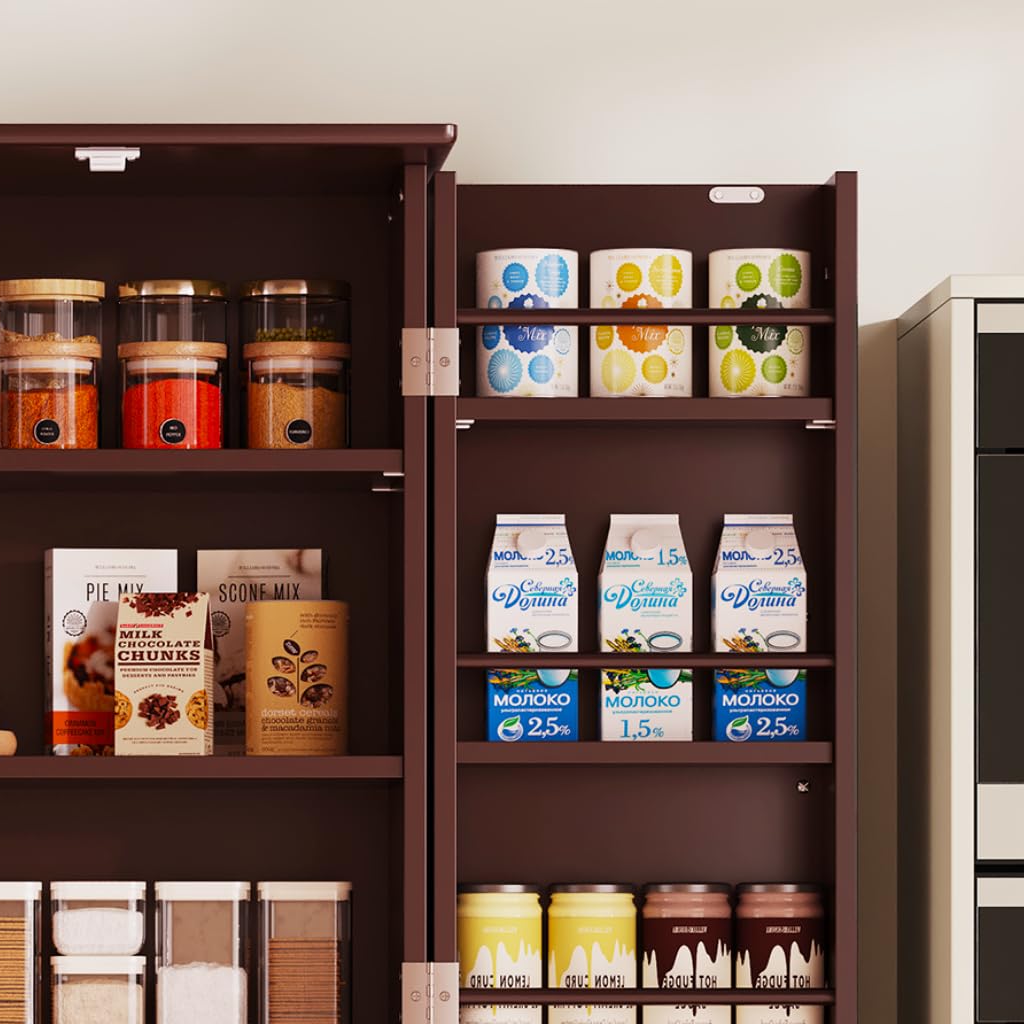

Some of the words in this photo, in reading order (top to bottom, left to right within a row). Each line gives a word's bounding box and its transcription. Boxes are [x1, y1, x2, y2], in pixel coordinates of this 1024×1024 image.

[519, 326, 547, 342] Mix
[632, 326, 661, 342] Mix
[751, 326, 781, 342] Mix
[493, 550, 544, 561] МОЛ
[605, 550, 655, 561] МОЛ
[722, 550, 772, 561] МОЛ
[86, 582, 110, 602] PIE
[274, 583, 301, 601] MIX
[492, 584, 568, 611] Долина
[603, 584, 678, 611] Долина
[720, 584, 797, 611] Долина
[120, 630, 163, 639] MILK
[118, 640, 201, 649] CHOCOLATE
[118, 650, 201, 661] CHUNKS
[493, 693, 571, 707] МОЛОКО
[605, 695, 681, 708] МОЛОКО
[722, 693, 800, 707] МОЛОКО
[527, 716, 571, 738] 2,5%
[620, 719, 665, 740] 1,5%
[756, 716, 800, 739] 2,5%
